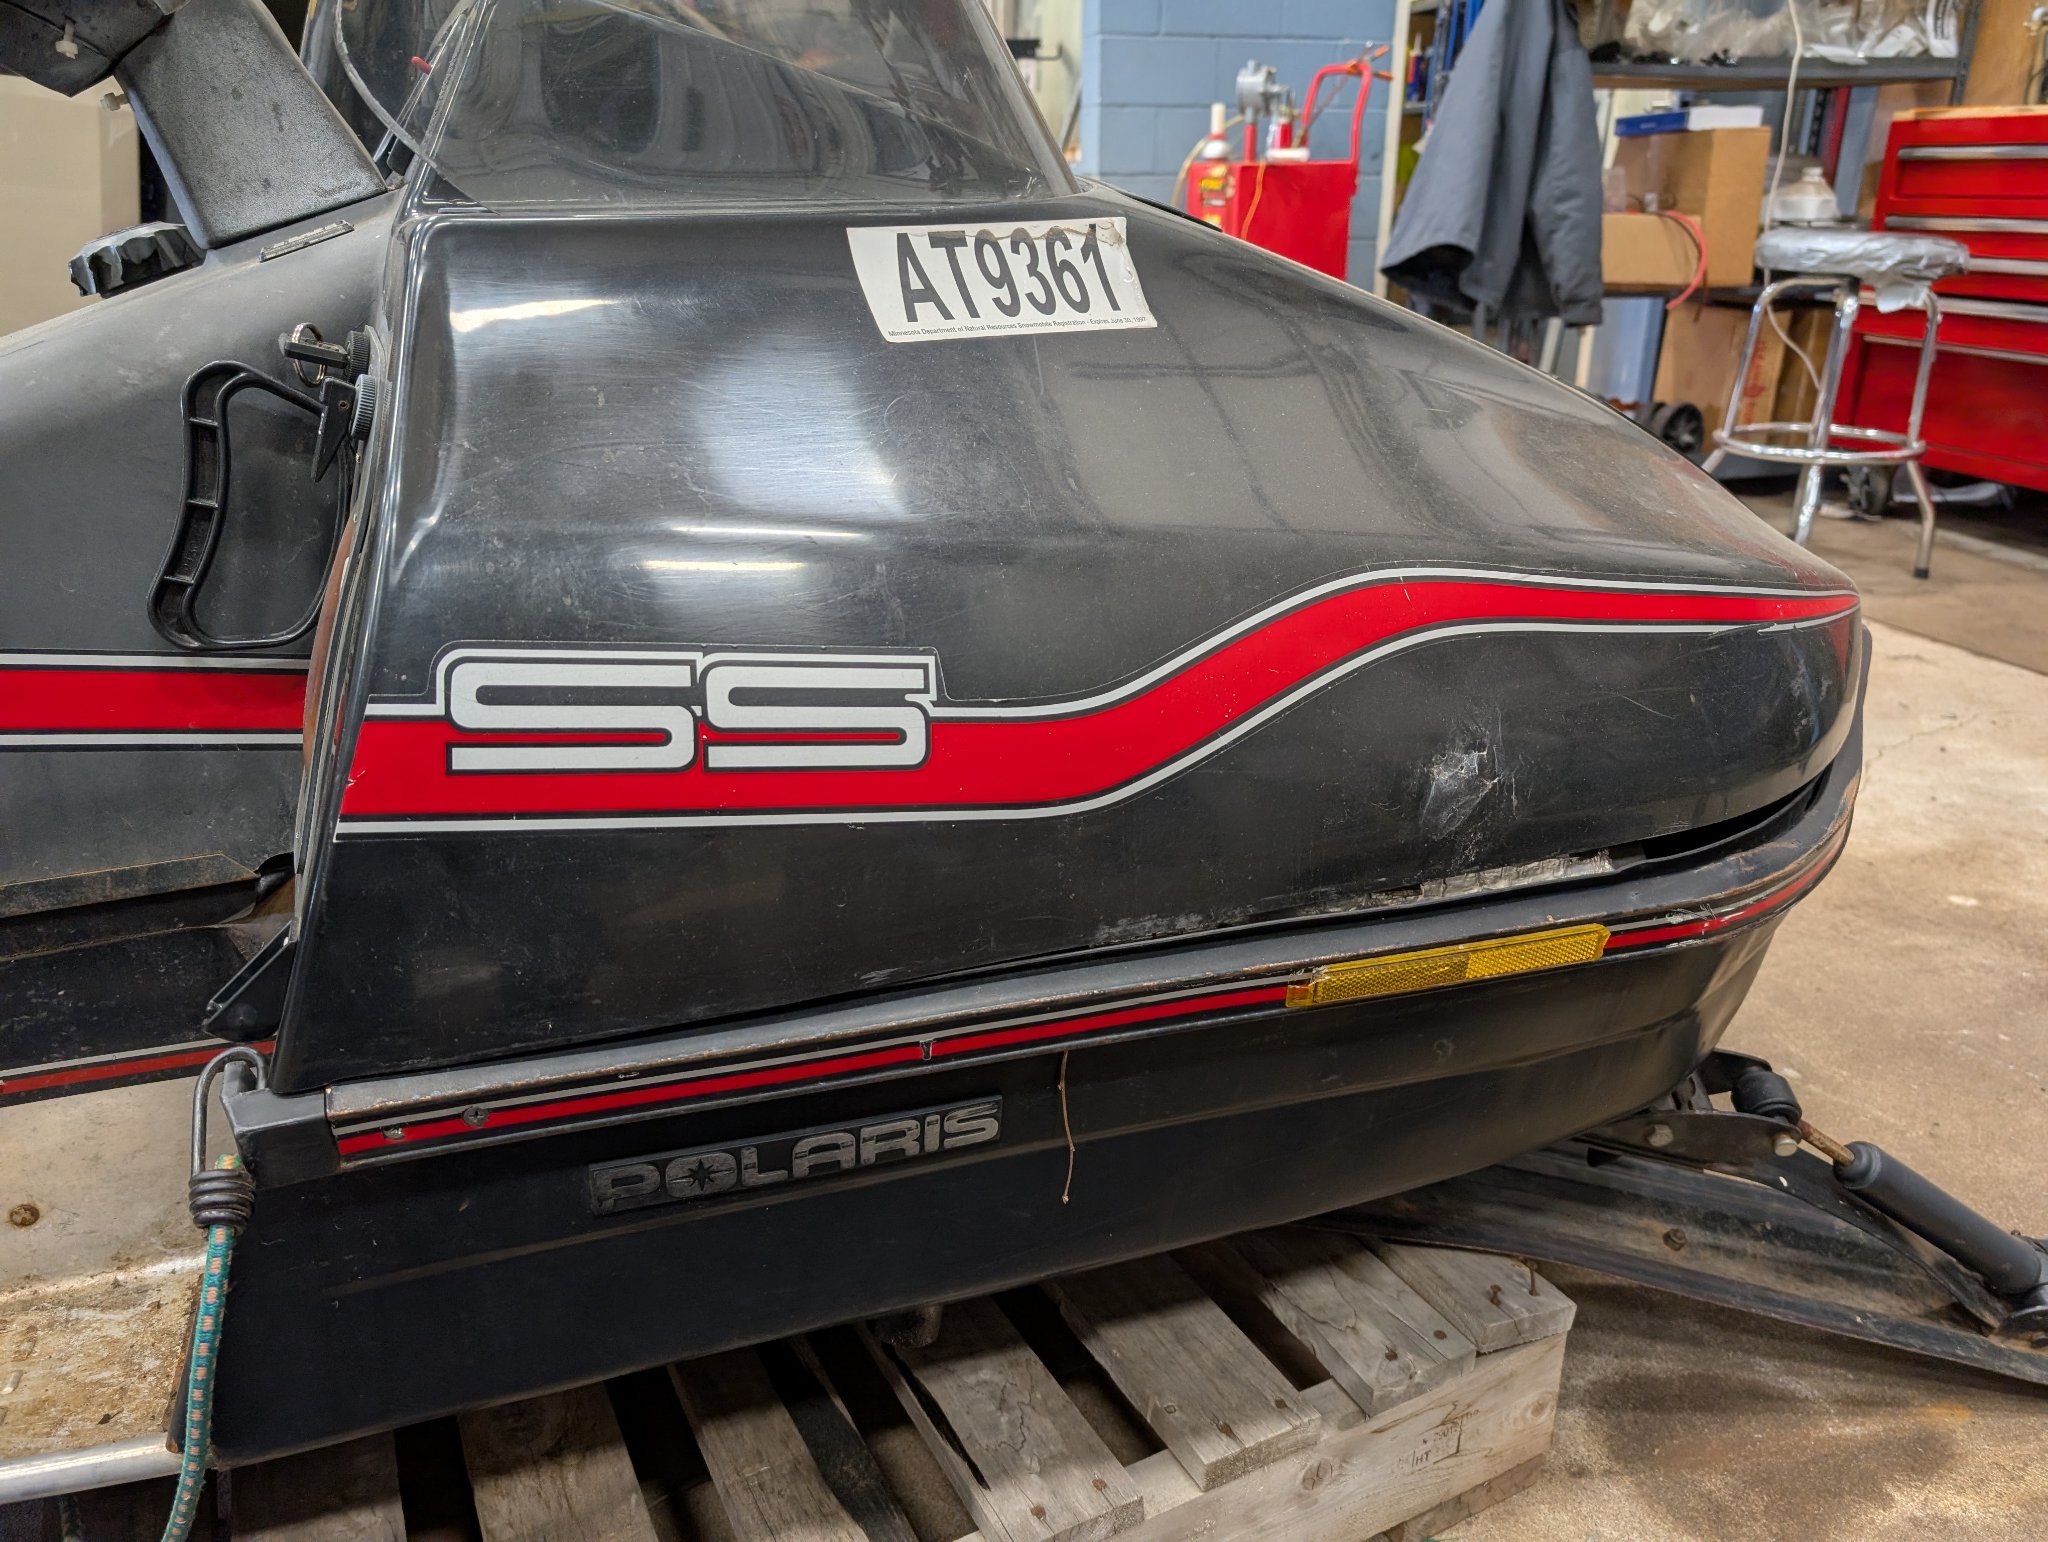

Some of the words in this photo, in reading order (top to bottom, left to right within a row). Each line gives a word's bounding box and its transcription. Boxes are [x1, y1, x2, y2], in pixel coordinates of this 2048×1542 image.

[896, 224, 1121, 323] AT9361
[888, 329, 921, 337] Minnesota
[921, 327, 957, 336] Department
[987, 323, 1017, 331] Resources
[1017, 321, 1052, 329] Snowmobile
[1053, 319, 1086, 328] Registration
[1090, 317, 1110, 326] Expires
[1110, 317, 1122, 325] June
[447, 658, 930, 773] SS
[596, 1103, 999, 1211] POLARIS
